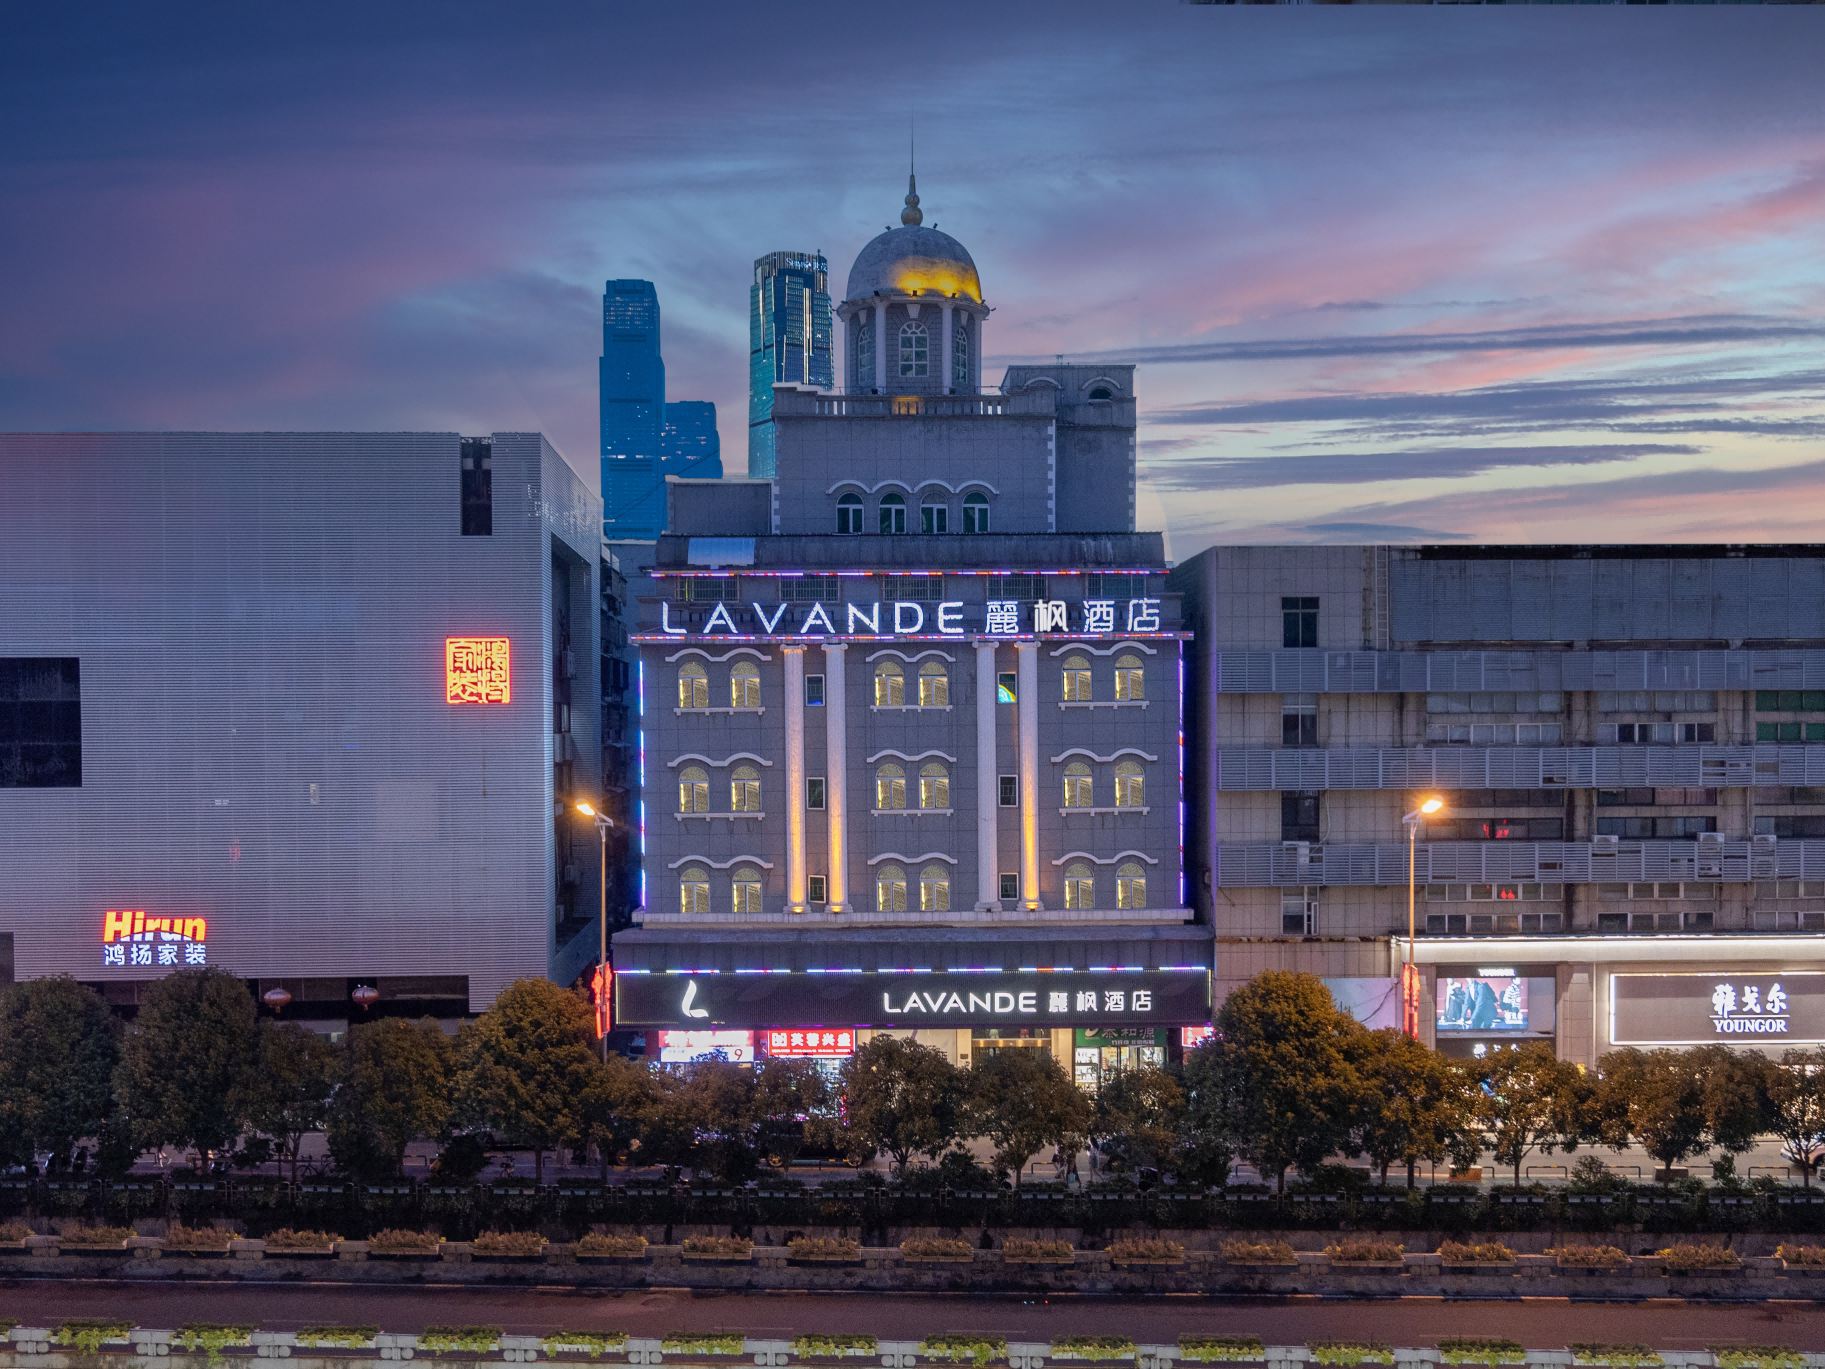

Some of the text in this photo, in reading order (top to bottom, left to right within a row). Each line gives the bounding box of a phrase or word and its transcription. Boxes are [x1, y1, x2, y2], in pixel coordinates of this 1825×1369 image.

[661, 597, 1161, 635] LAVANDE 麗枫酒店
[103, 910, 206, 942] Hirun
[104, 943, 207, 966] 鸿扬家装
[883, 990, 1152, 1013] LAVANDE 麗枫酒店
[1711, 982, 1787, 1019] 雅戈尔
[1712, 1019, 1788, 1033] YOUNGOR
